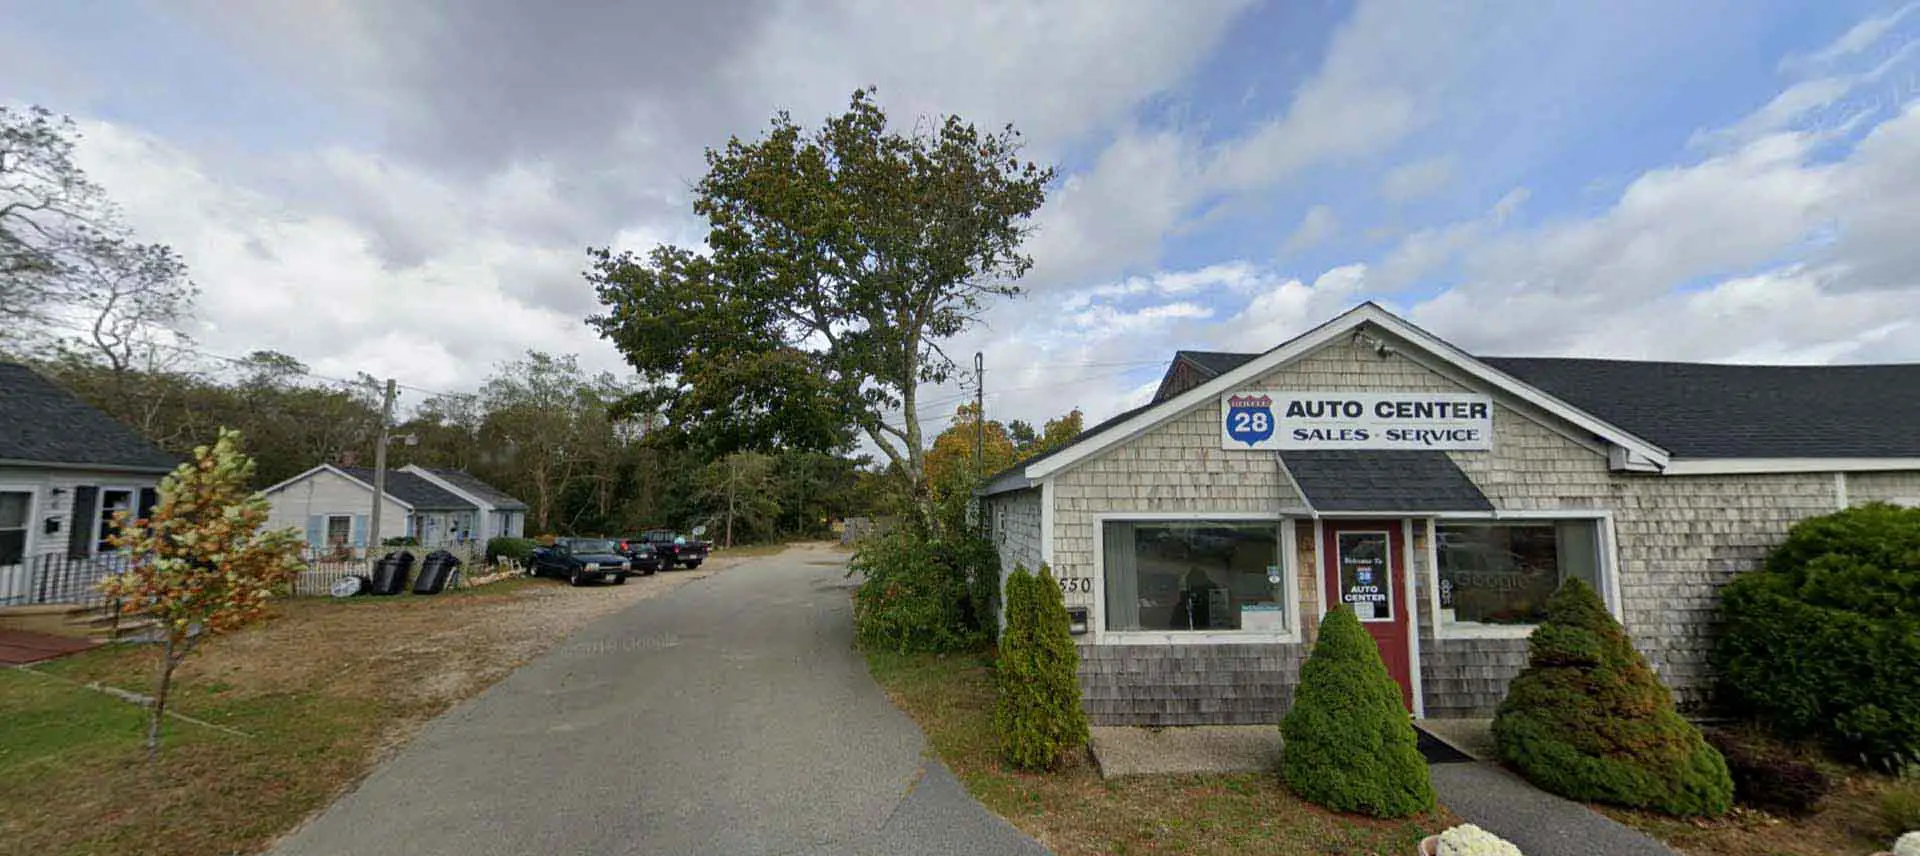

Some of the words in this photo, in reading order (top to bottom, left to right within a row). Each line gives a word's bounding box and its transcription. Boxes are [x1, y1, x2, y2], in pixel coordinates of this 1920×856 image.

[1286, 401, 1363, 418] AUTO
[1375, 401, 1487, 419] CENTER
[1235, 412, 1267, 432] 28
[1293, 428, 1369, 441] SALES
[1386, 428, 1479, 444] SERVICE
[1060, 577, 1091, 593] 550
